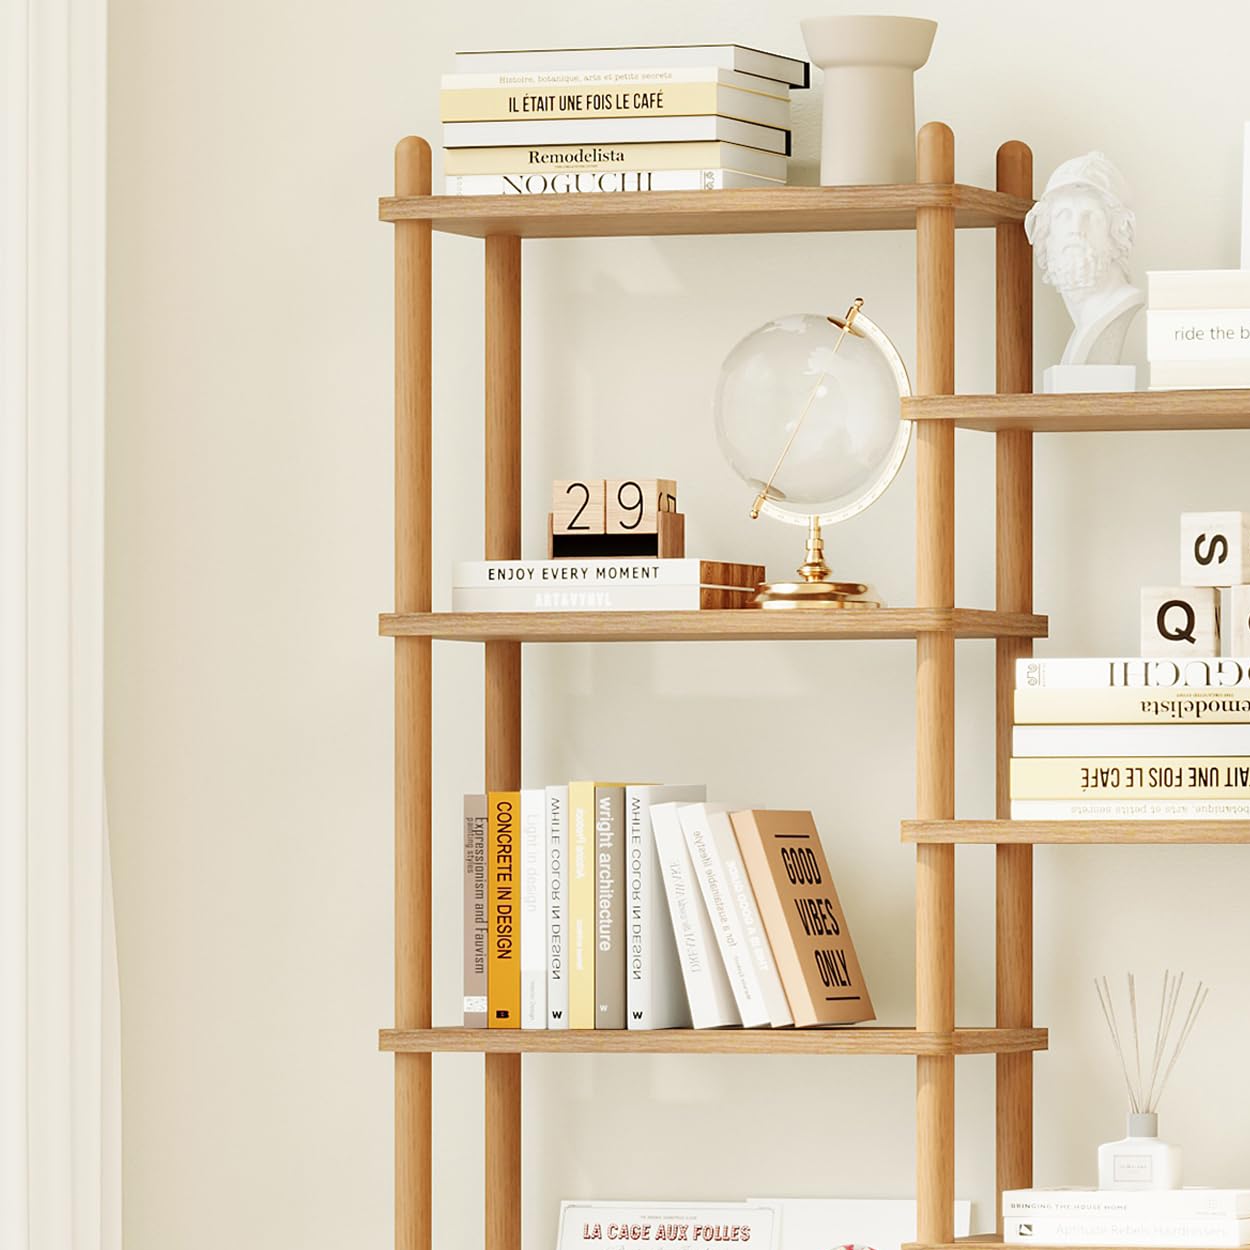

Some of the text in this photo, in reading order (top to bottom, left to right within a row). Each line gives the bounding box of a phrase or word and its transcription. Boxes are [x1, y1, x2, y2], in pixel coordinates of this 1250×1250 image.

[509, 89, 664, 113] IL ÉTAIT UNE FOIS LE CAFÉ
[529, 149, 625, 165] Remodelista
[502, 172, 653, 195] NOGUCHI
[1174, 326, 1205, 341] ride
[1210, 326, 1235, 341] the
[566, 481, 644, 530] 29
[488, 566, 660, 581] ENJOY EVERY MOMENT
[1157, 599, 1197, 644] Q
[1081, 767, 1120, 792] CAFÉ
[1124, 766, 1143, 787] LE
[1149, 766, 1184, 787] FOIS
[1188, 766, 1219, 787] UNE
[465, 817, 474, 874] painting styles
[597, 797, 612, 952] wright architecture
[781, 847, 822, 885] GOOD
[497, 801, 512, 960] CONCRETE IN DESIGN
[475, 903, 488, 924] and
[794, 898, 840, 936] VIBES
[475, 927, 488, 974] Fauvism
[815, 949, 852, 987] ONLY
[583, 1223, 751, 1242] LA CAGE AUX FOLLES
